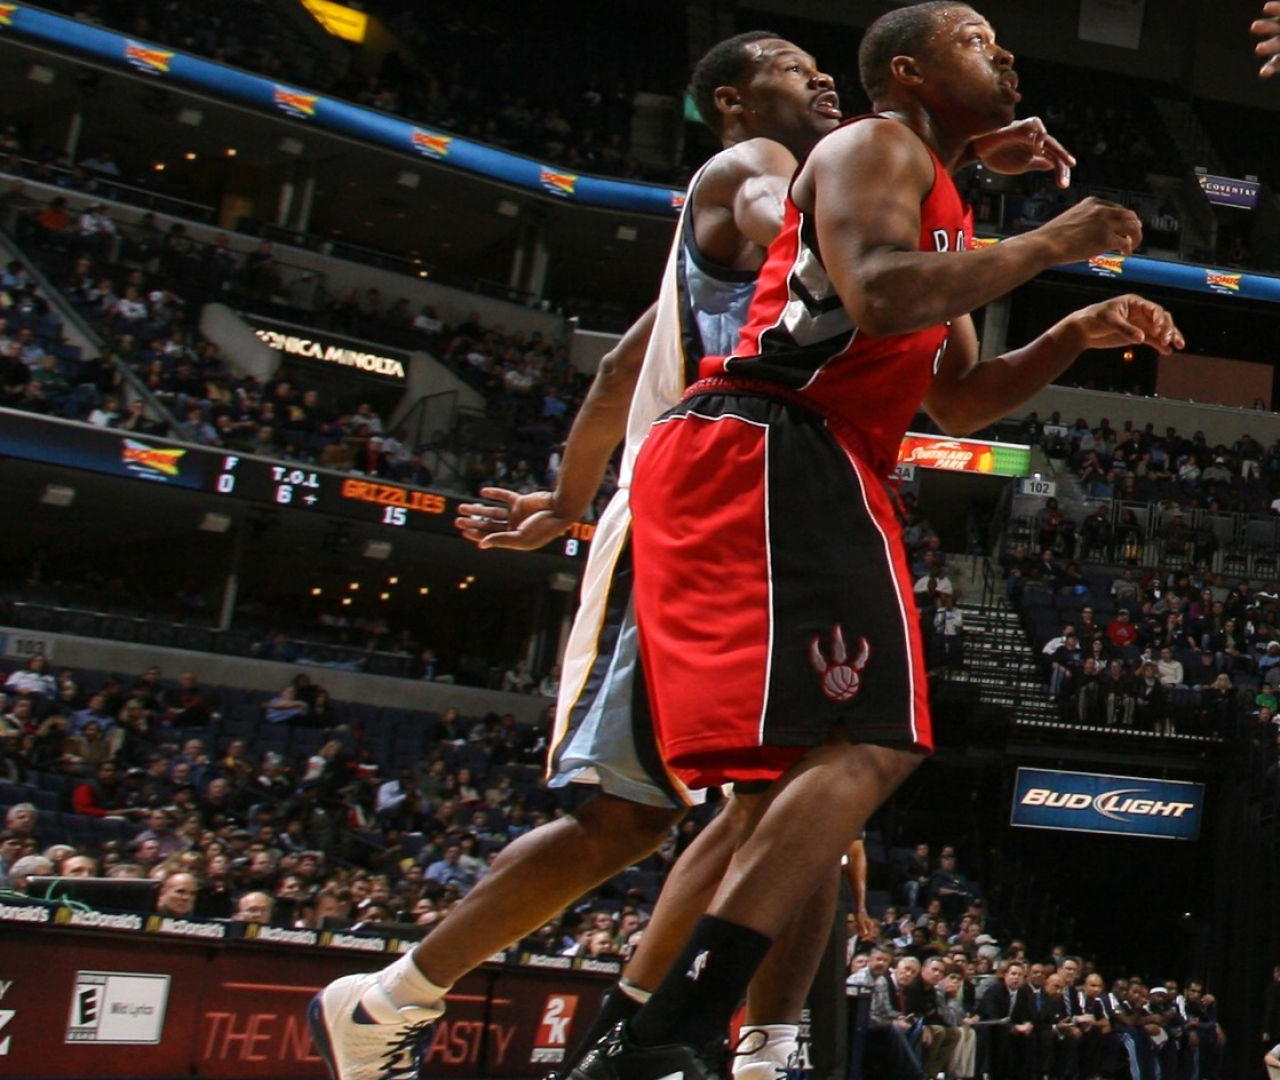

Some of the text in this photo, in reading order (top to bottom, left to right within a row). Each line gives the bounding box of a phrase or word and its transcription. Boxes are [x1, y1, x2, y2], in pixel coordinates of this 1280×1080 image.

[324, 346, 405, 377] MINOLTA
[276, 485, 292, 504] 6
[341, 479, 446, 513] GRIZZLIES
[1030, 482, 1050, 494] 102
[383, 506, 407, 526] 15
[565, 539, 577, 556] 8
[1021, 788, 1194, 817] BUD LIGHT
[79, 988, 98, 1026] E
[203, 1011, 273, 1062] THE
